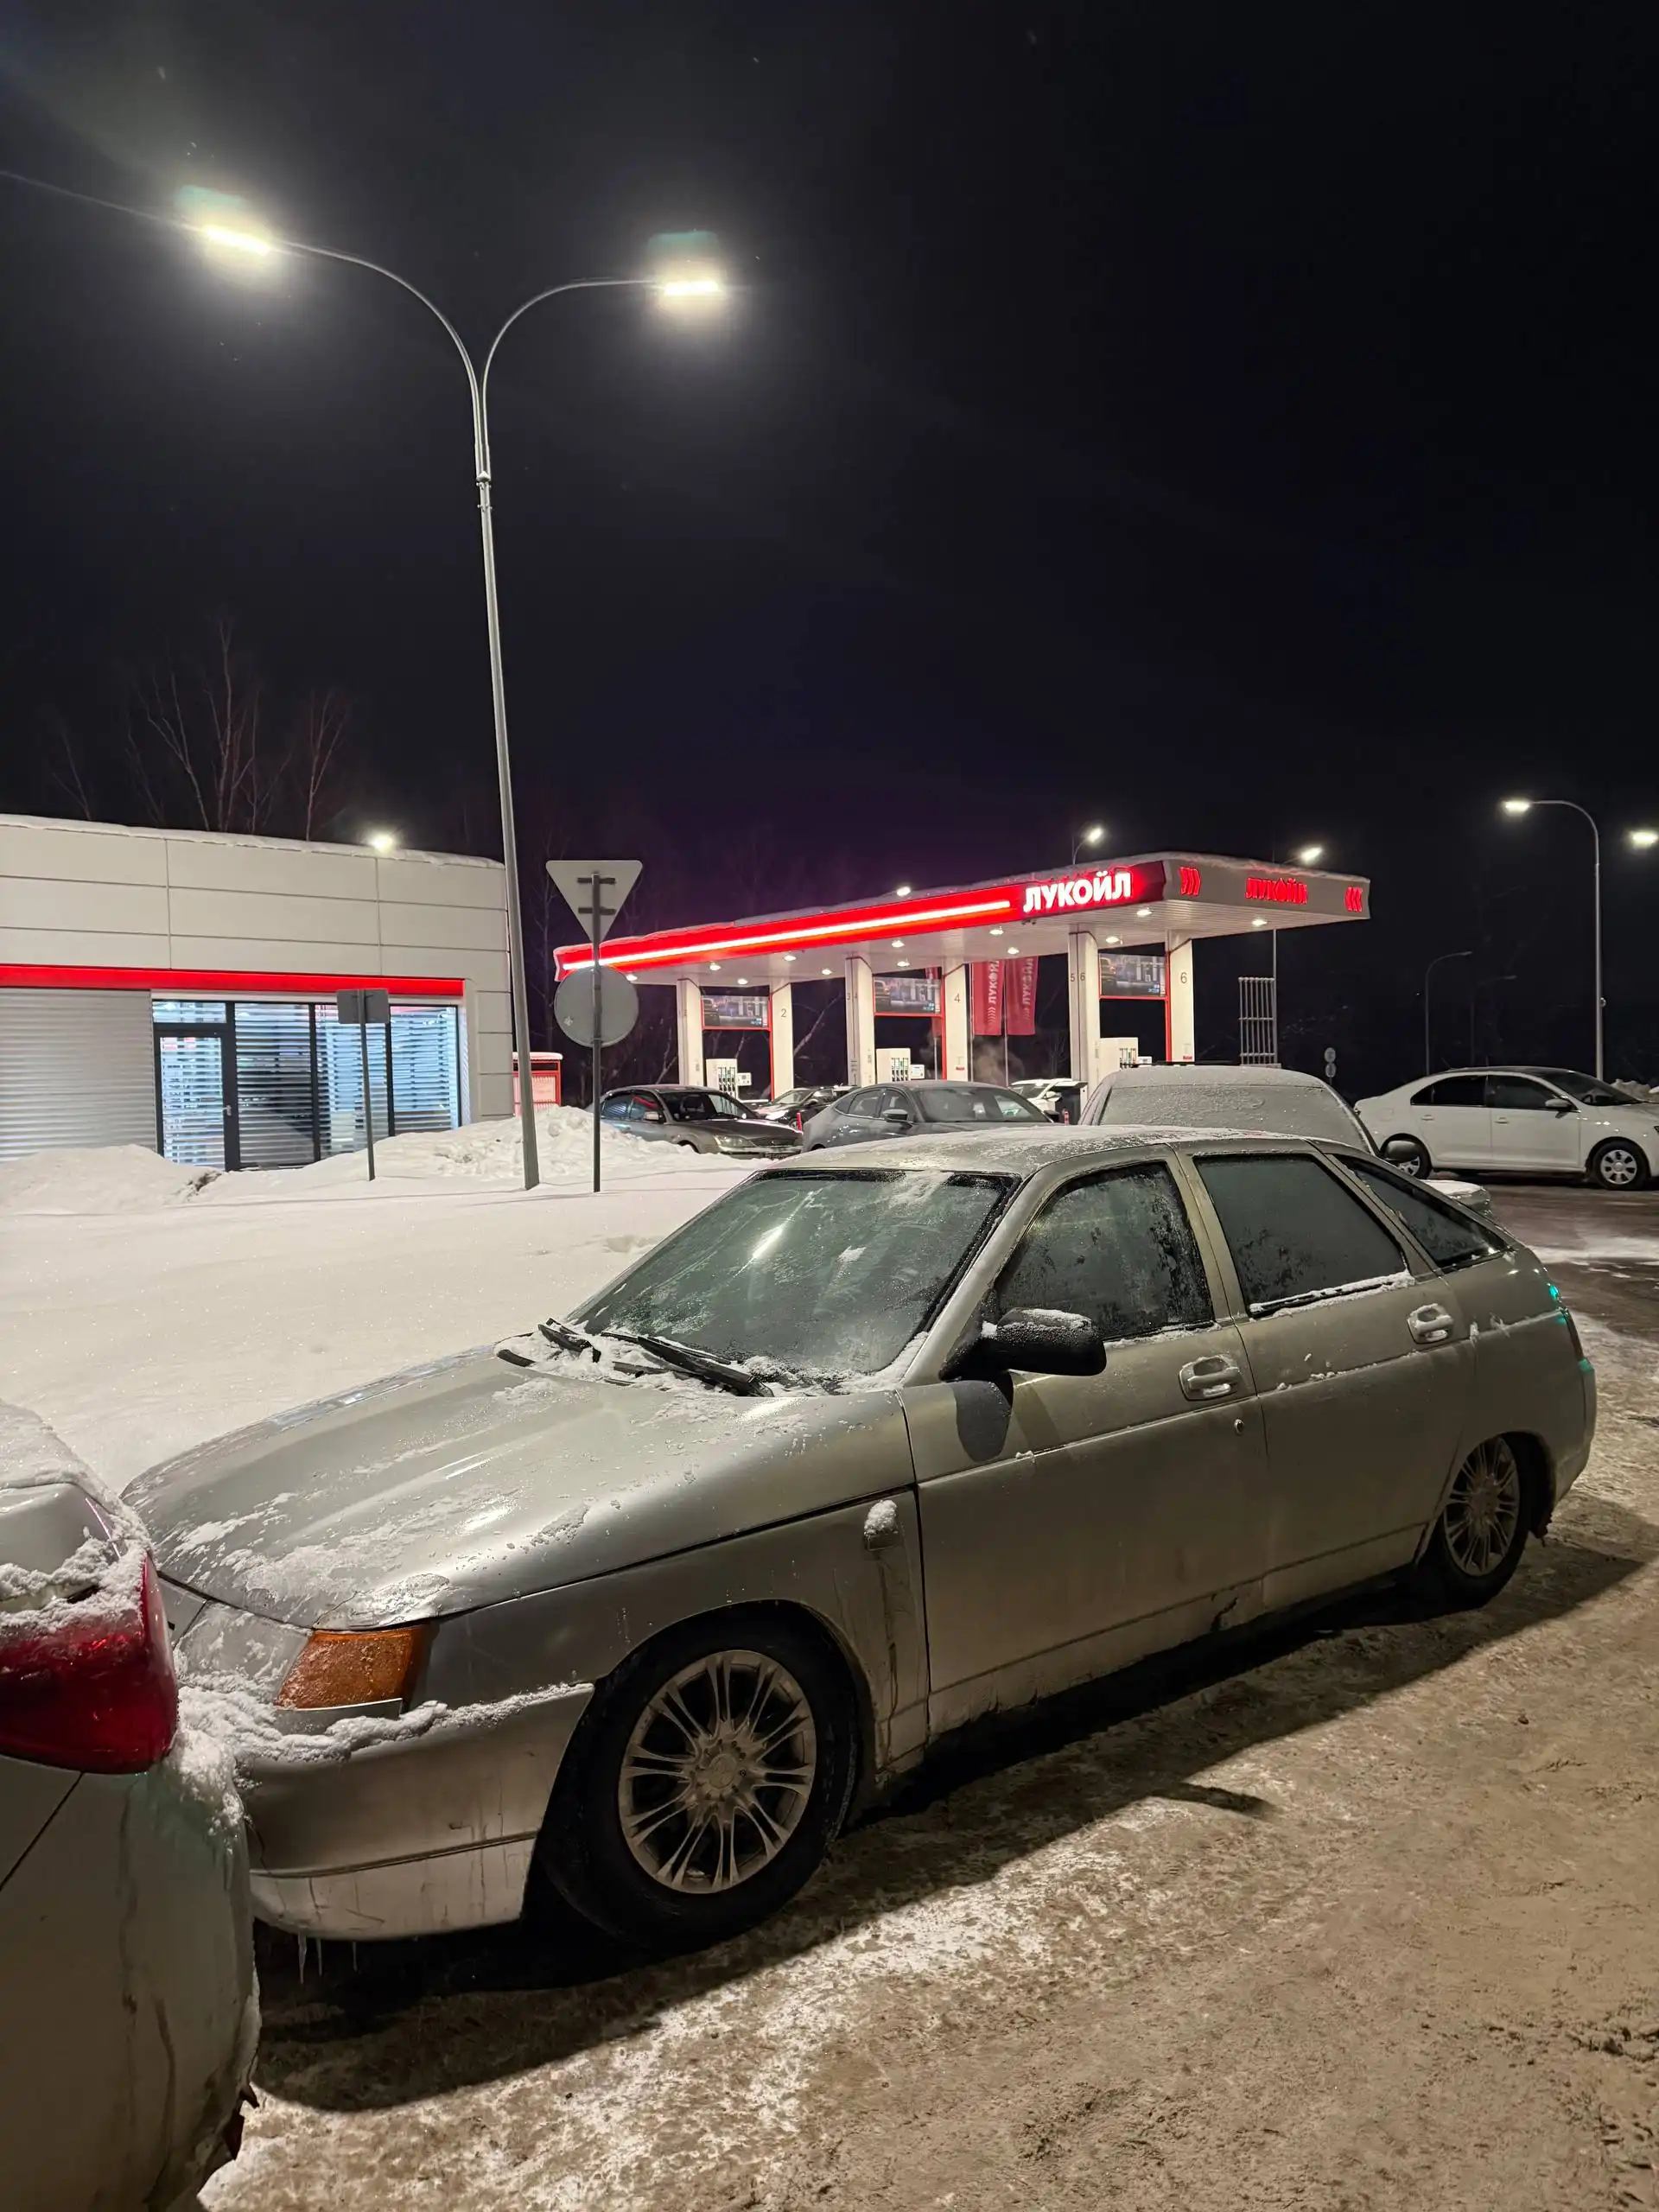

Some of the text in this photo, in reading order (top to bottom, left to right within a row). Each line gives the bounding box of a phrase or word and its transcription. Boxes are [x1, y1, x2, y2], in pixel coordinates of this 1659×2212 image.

[1023, 870, 1131, 912] ЛУКОЙЛ
[1245, 877, 1307, 905] ЛУКОЙЛ
[1179, 971, 1188, 984] 6
[954, 993, 962, 1003] 4
[780, 1007, 787, 1018] 2
